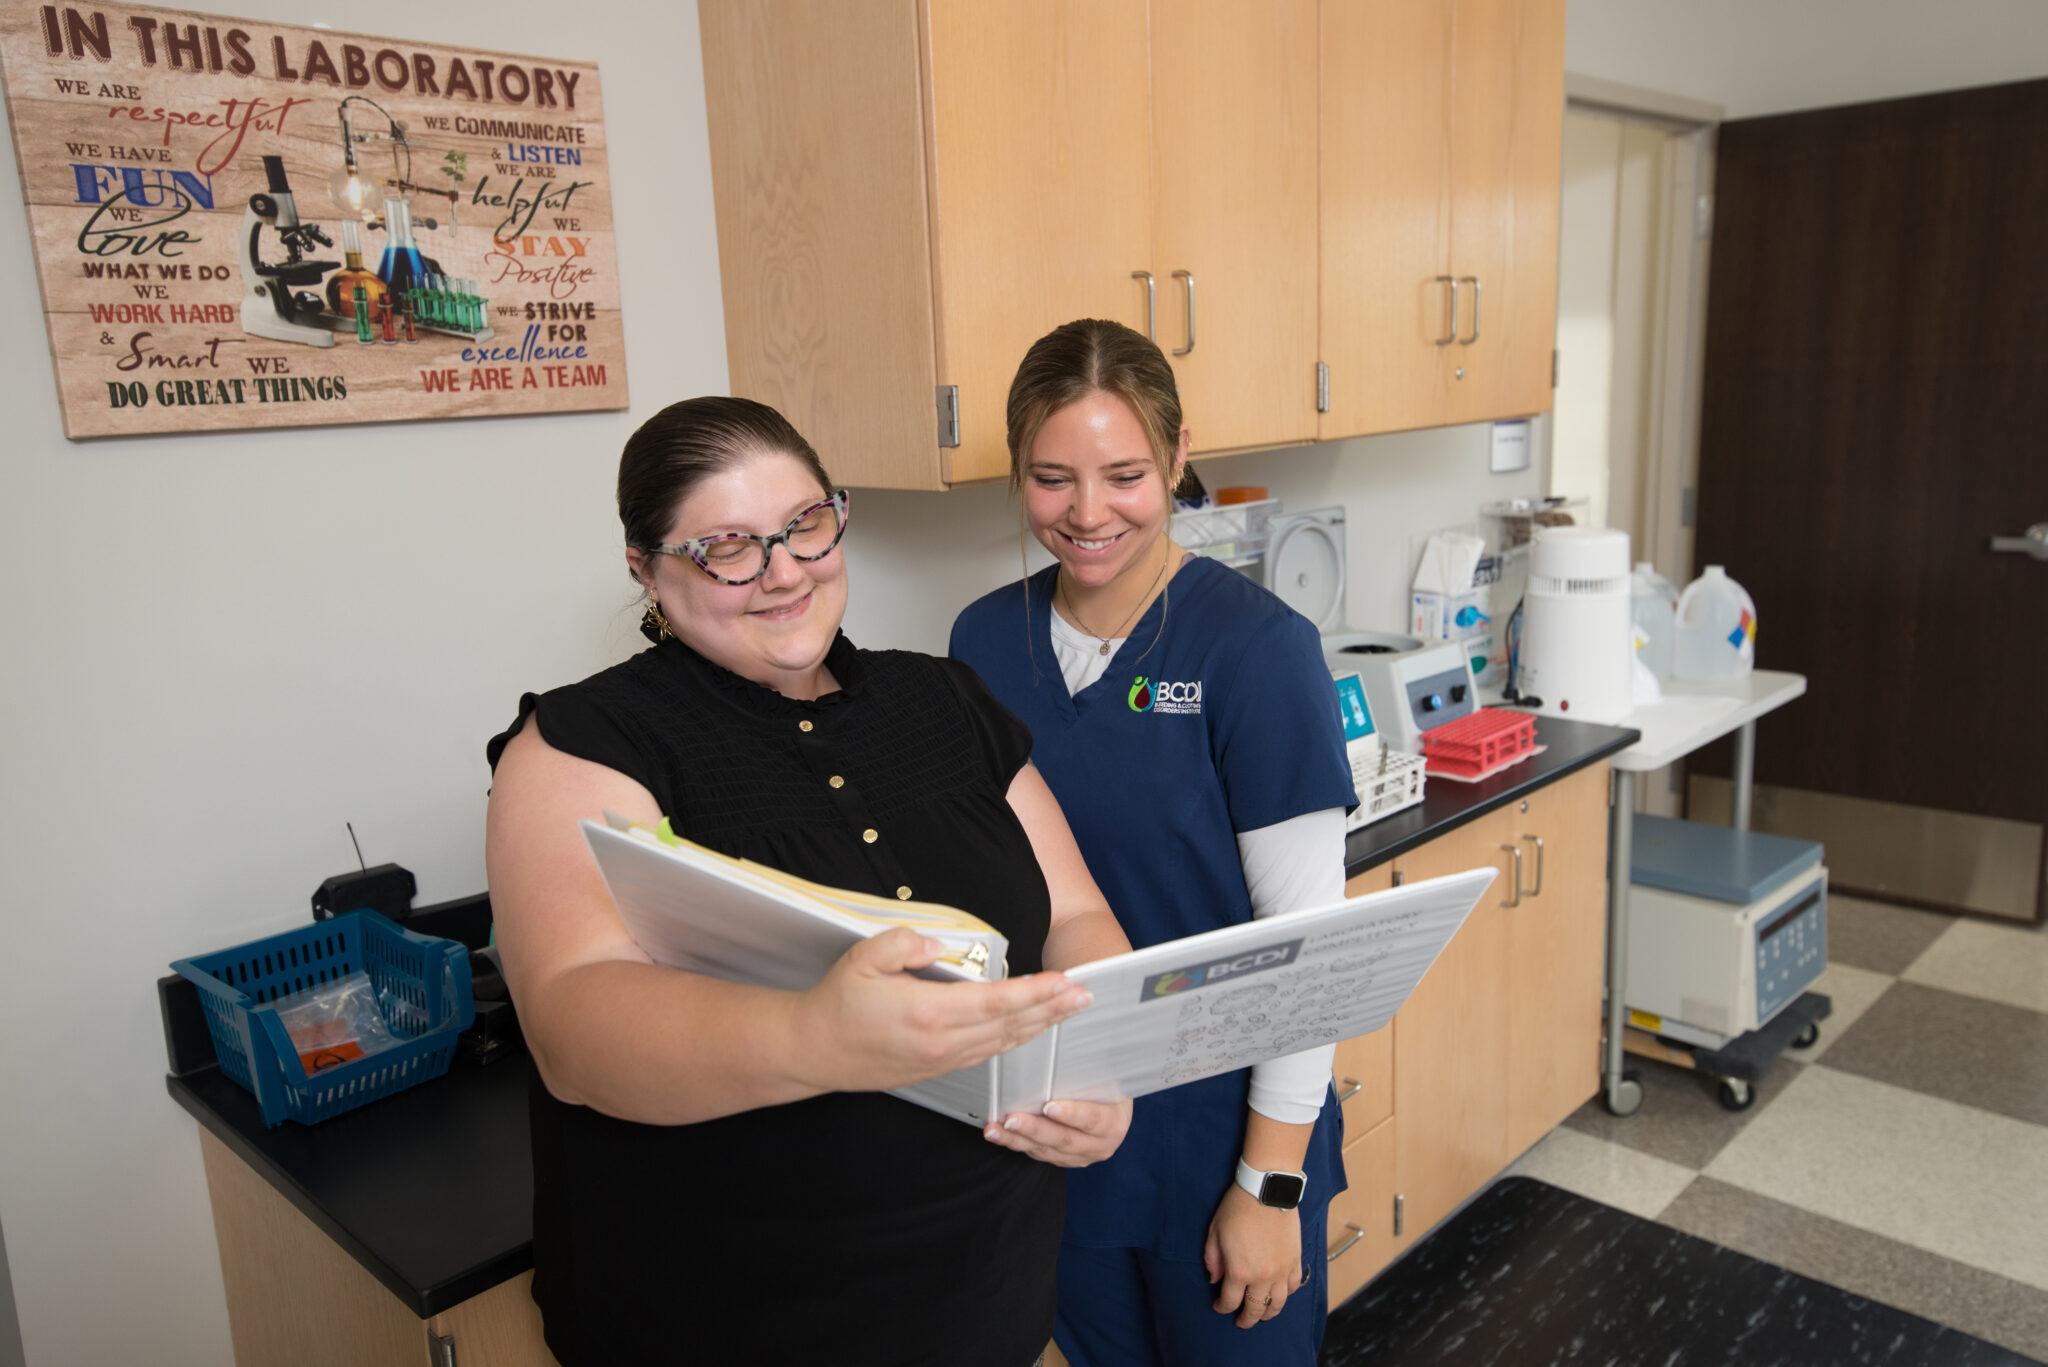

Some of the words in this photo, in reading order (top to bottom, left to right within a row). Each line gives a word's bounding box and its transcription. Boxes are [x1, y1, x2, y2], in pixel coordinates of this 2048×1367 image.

[39, 5, 112, 63] IN
[126, 15, 257, 78] THIS
[271, 34, 580, 111] LABORATORY
[54, 78, 90, 96] WE
[98, 84, 142, 100] ARE
[108, 97, 313, 176] respectful
[423, 116, 449, 130] WE
[454, 116, 587, 144] COMMUNICATE
[65, 142, 102, 158] WE
[110, 145, 172, 163] HAVE
[490, 149, 502, 160] &
[506, 143, 582, 166] LISTEN
[495, 163, 520, 176] WE
[525, 166, 557, 178] ARE
[69, 163, 215, 209] FUN
[109, 208, 143, 222] WE
[472, 176, 593, 244] helpful
[553, 218, 581, 231] WE
[493, 235, 591, 257] STAY
[82, 262, 149, 280] WHAT
[158, 264, 192, 281] WE
[198, 265, 231, 281] DO
[484, 252, 597, 299] Positive
[133, 284, 169, 300] WE
[88, 303, 165, 324] WORK
[171, 303, 234, 324] HARD
[496, 306, 518, 317] WE
[525, 302, 596, 320] STRIVE
[461, 324, 588, 364] excellence
[548, 325, 588, 342] FOR
[100, 331, 115, 345] &
[116, 331, 247, 372] Smart
[246, 356, 290, 375] WE
[421, 369, 461, 393] WE
[469, 367, 513, 390] ARE
[522, 366, 537, 389] A
[543, 364, 607, 388] TEAM
[106, 381, 149, 409] DO
[155, 377, 246, 407] GREAT
[252, 375, 348, 402] THINGS
[1155, 680, 1202, 703] BCDI
[1206, 947, 1289, 981] BCDI
